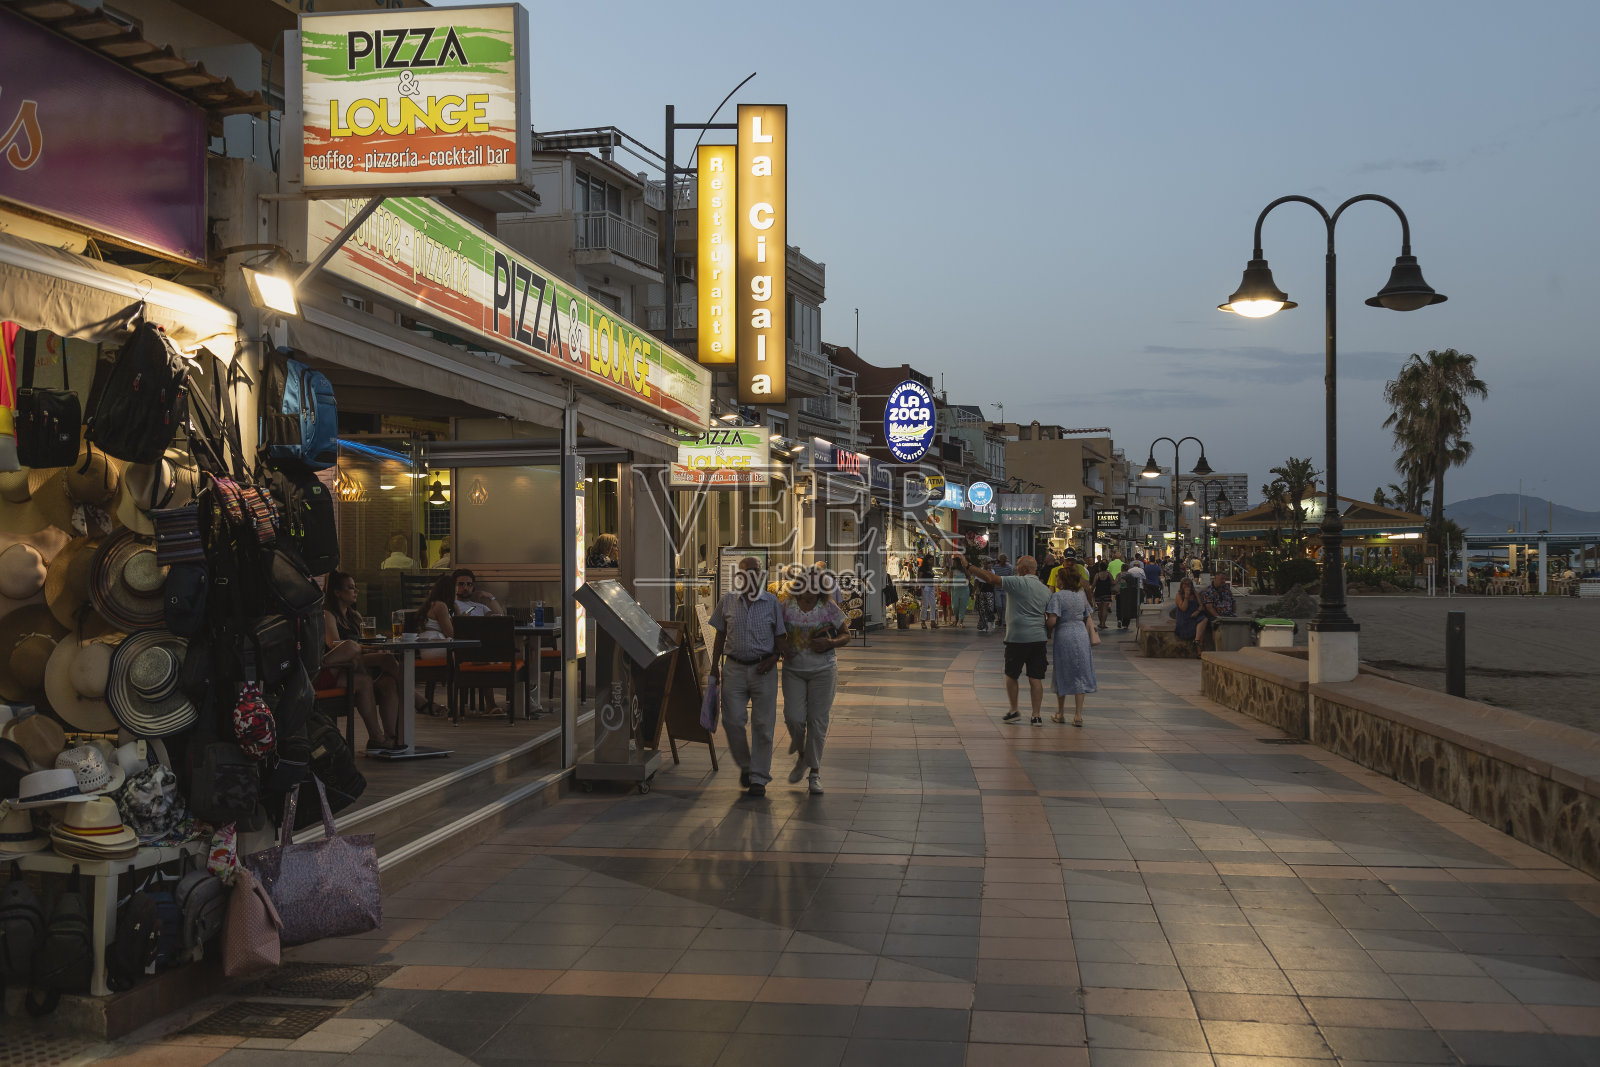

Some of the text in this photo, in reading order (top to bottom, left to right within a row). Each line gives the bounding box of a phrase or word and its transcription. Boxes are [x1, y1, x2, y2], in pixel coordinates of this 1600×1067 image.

[347, 26, 468, 70] PIZZA
[398, 70, 420, 96] &
[330, 93, 489, 137] LOUNGE
[310, 145, 510, 172] coffee pizzería cocktail bar
[413, 220, 469, 297] pizzería
[710, 157, 723, 352] Restaurante
[748, 117, 775, 394] La Cigala
[493, 249, 563, 360] PIZZA
[568, 298, 583, 364] &
[589, 307, 651, 398] LOUNGE
[890, 383, 930, 404] RESTAURANTE
[900, 395, 920, 407] LA
[889, 407, 930, 421] ZOCA
[688, 455, 751, 470] LOUNGE
[715, 445, 725, 456] &
[836, 448, 845, 472] LA
[845, 451, 860, 476] ZOCA
[892, 446, 925, 460] PESCAITOS
[673, 472, 694, 481] coffee
